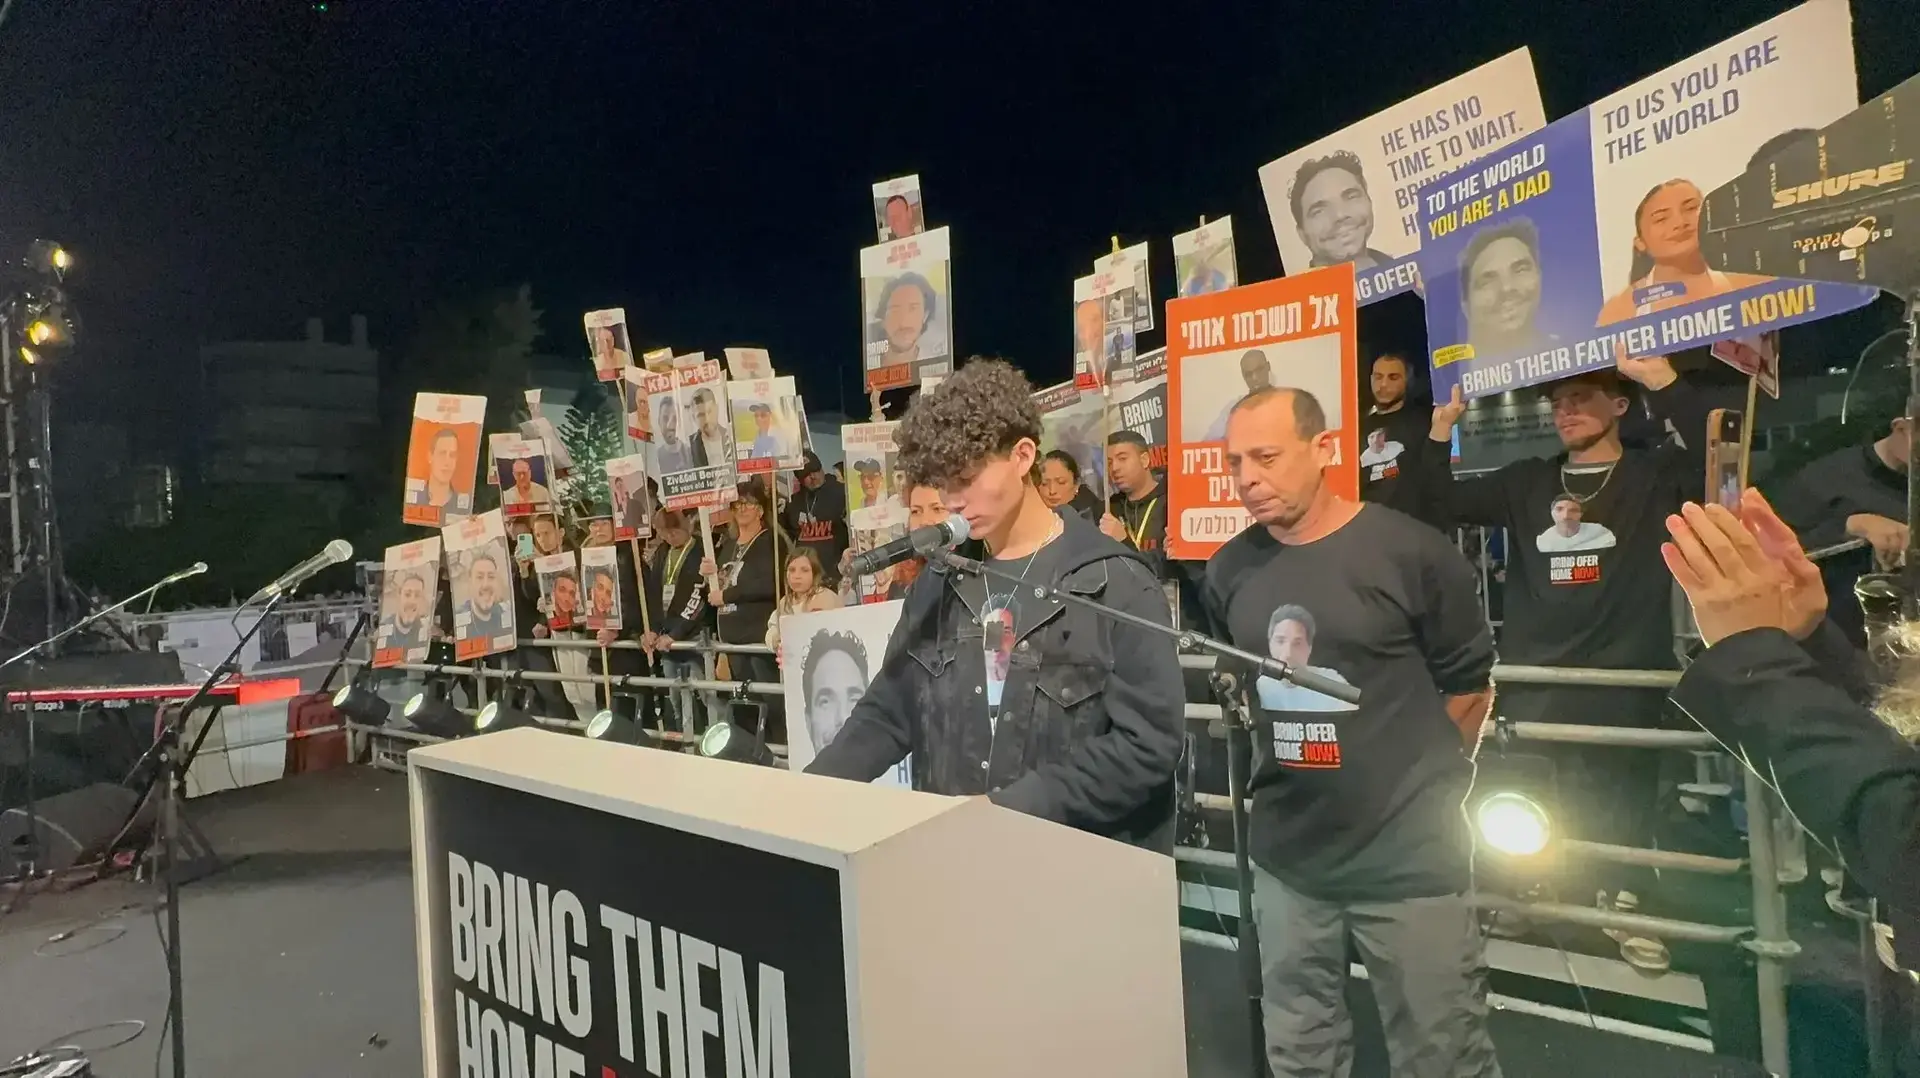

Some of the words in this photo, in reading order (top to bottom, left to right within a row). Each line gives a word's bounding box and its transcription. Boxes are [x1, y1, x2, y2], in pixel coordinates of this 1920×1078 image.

[1603, 105, 1630, 134] TO
[1636, 89, 1665, 120] US
[1671, 63, 1718, 103] YOU
[1727, 35, 1780, 81] ARE
[1381, 128, 1407, 156] HE
[1409, 109, 1450, 144] HAS
[1453, 96, 1482, 125] NO
[1387, 147, 1435, 182] TIME
[1436, 135, 1463, 162] TO
[1465, 111, 1524, 150] WAIT.
[1604, 127, 1647, 164] THE
[1653, 88, 1740, 144] WORLD
[1426, 190, 1446, 215] TO
[1448, 173, 1480, 205] THE
[1483, 143, 1545, 190] WORLD
[1428, 210, 1457, 240] YOU
[1461, 194, 1494, 227] ARE
[1497, 188, 1509, 211] A
[1513, 170, 1551, 204] DAD
[1772, 161, 1906, 209] SHURE
[1181, 316, 1225, 350] אותי
[1232, 302, 1302, 343] תשכחו
[1309, 294, 1340, 330] אל
[1462, 362, 1513, 395] BRING
[1515, 346, 1571, 381] THEIR
[1575, 324, 1657, 367] FATHER
[1661, 304, 1735, 345] HOME
[1740, 284, 1816, 328] NOW!
[1123, 396, 1163, 428] BRING
[1576, 555, 1599, 567] OFER
[1273, 721, 1304, 741] BRING
[1305, 723, 1337, 742] OFER
[1273, 740, 1304, 760] HOME
[1304, 743, 1341, 763] NOW!
[448, 851, 592, 1038] BRING
[600, 903, 791, 1078] THEM
